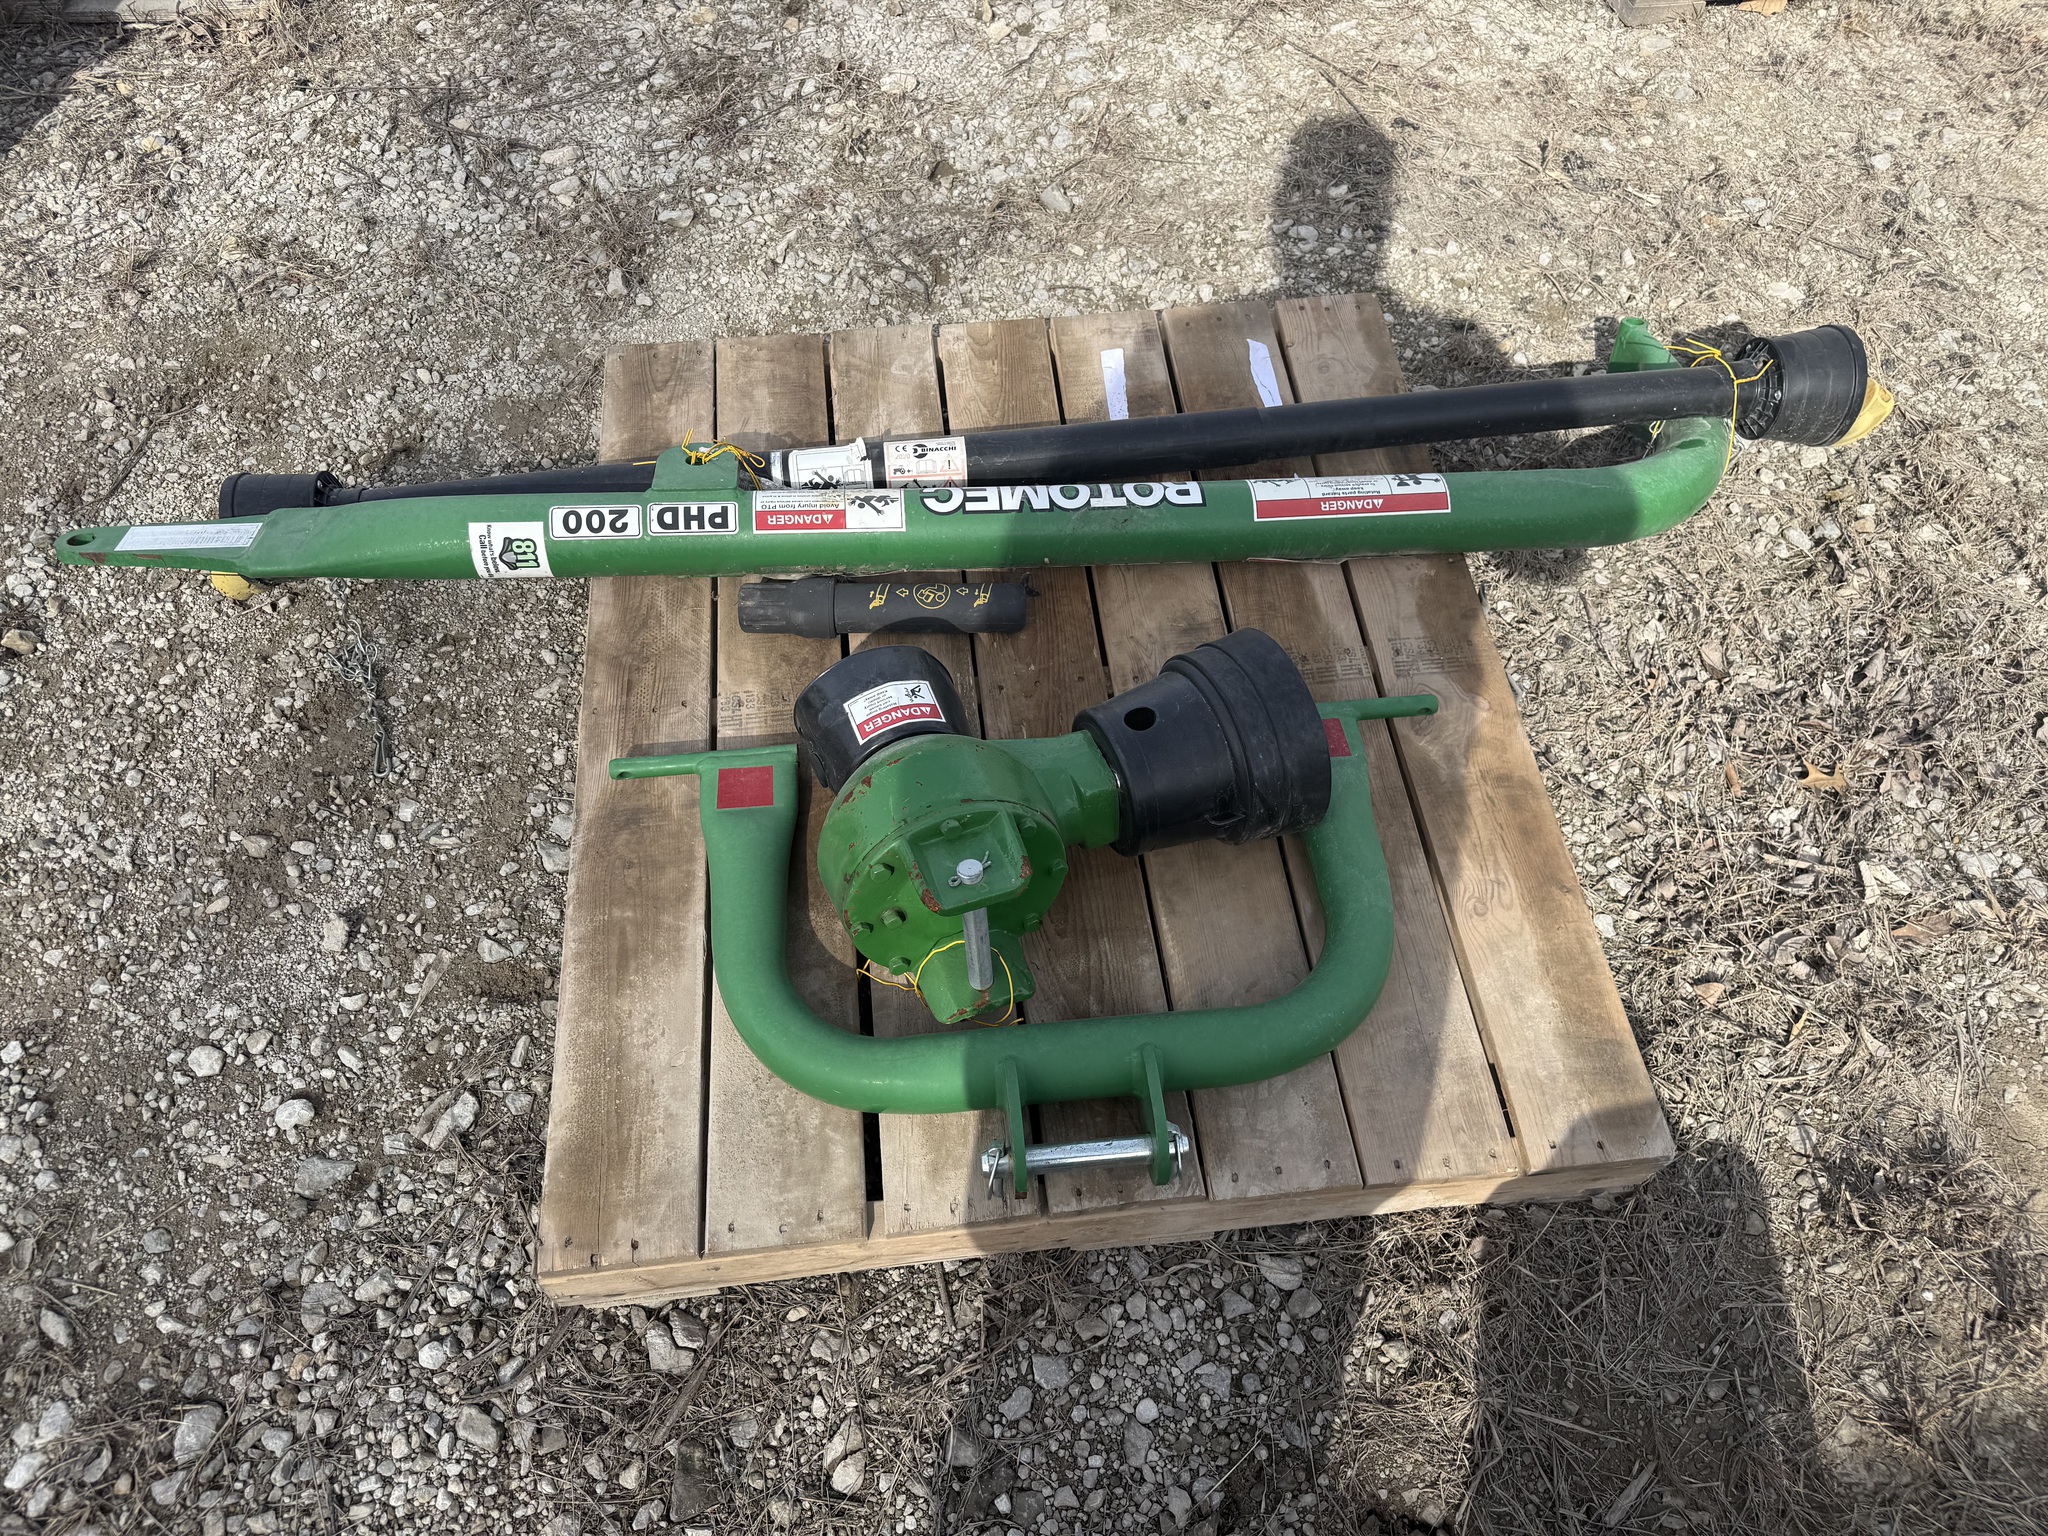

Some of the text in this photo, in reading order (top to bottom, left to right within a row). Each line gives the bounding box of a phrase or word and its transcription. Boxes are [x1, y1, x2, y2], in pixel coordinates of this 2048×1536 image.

[921, 481, 1204, 513] ROTOMEC
[1321, 499, 1373, 511] DANGER
[561, 509, 629, 534] 200
[655, 505, 729, 530] PHD
[767, 514, 821, 525] DANGER
[479, 534, 488, 549] Call
[511, 539, 540, 568] 811
[481, 550, 489, 567] before
[864, 707, 921, 732] DANGER
